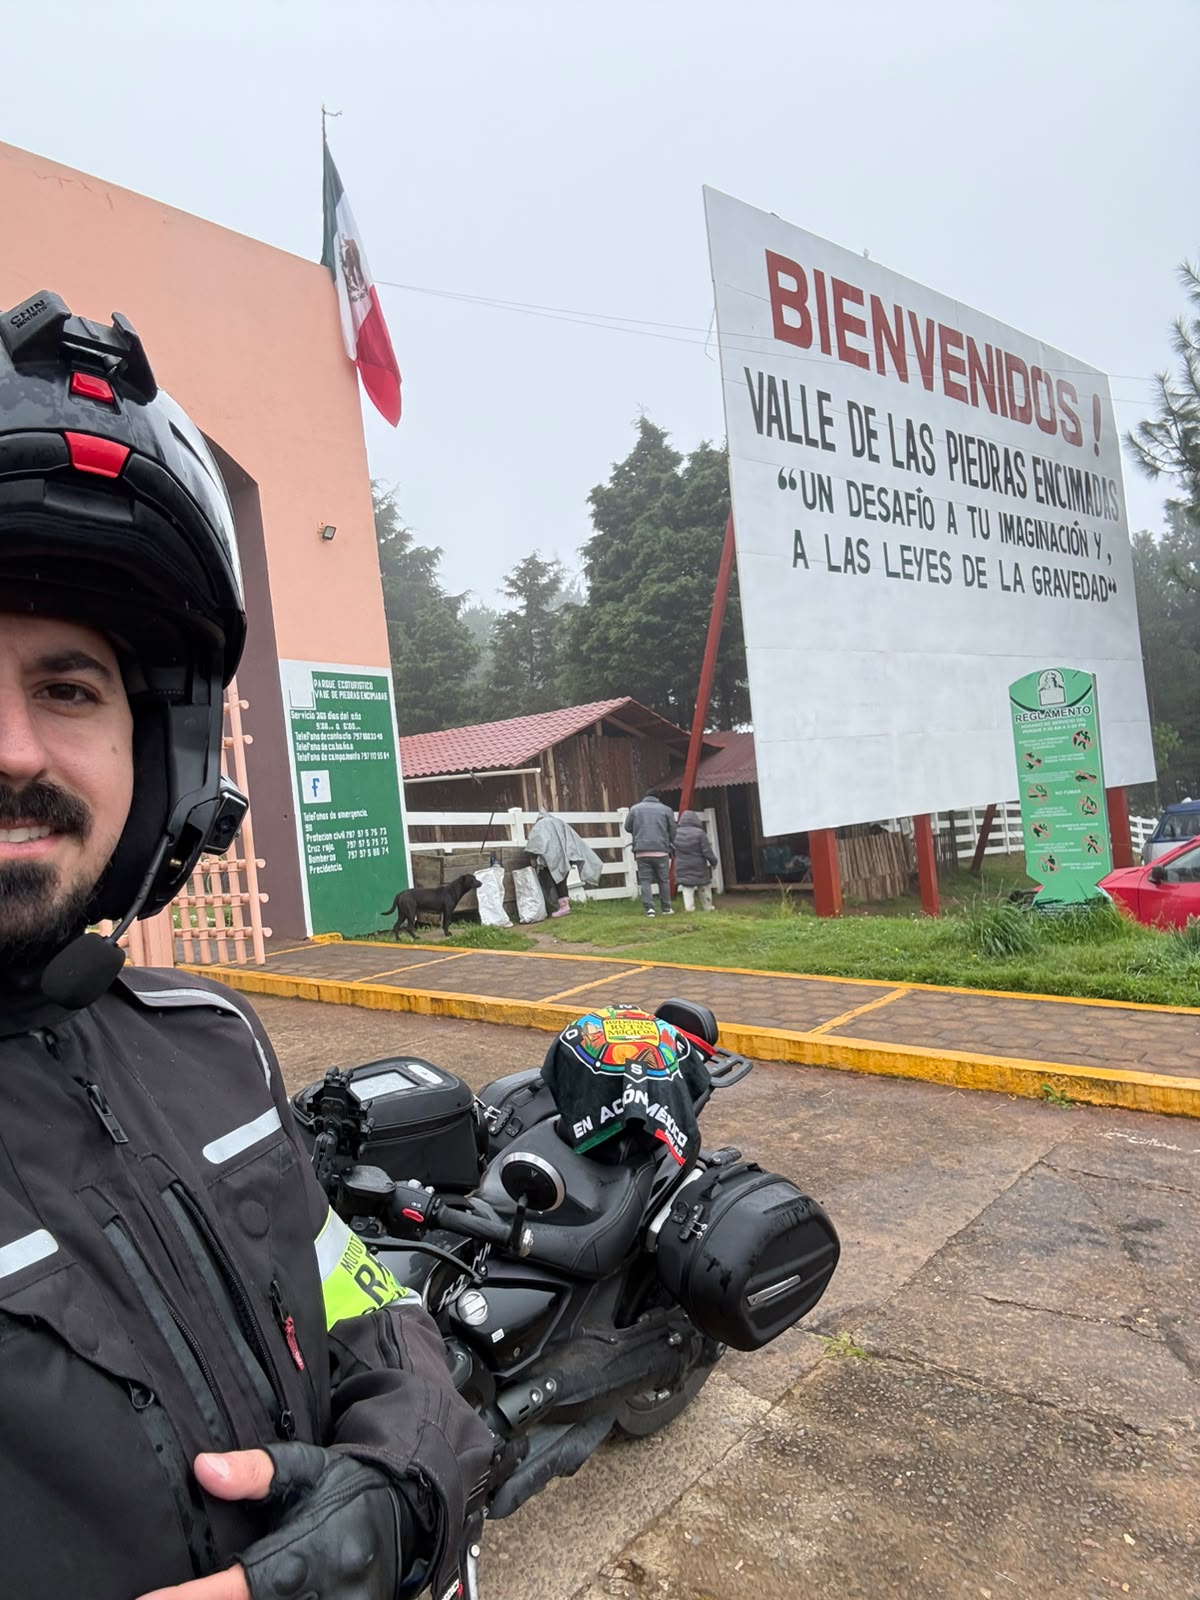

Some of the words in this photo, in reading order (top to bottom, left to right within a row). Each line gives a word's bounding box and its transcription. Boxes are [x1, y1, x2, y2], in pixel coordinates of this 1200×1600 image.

[765, 248, 1083, 447] BIENVENIDOS
[744, 366, 837, 452] VALLE
[847, 400, 881, 464] DE
[887, 412, 936, 477] LAS
[946, 429, 1028, 499] PIEDRAS
[1032, 455, 1120, 522] ENCIMADAS
[846, 480, 935, 531] DESAFÍO
[947, 501, 958, 535] A
[967, 505, 991, 540] TU
[998, 511, 1089, 558] IMAGINACIÓN
[792, 529, 810, 570] A
[824, 533, 871, 575] LAS
[883, 541, 952, 585] LEYES
[962, 553, 988, 589] DE
[998, 559, 1026, 593] LA
[313, 679, 336, 689] PARQUE
[331, 690, 339, 699] DE
[339, 691, 360, 700] PIEDRAS
[1015, 705, 1091, 722] REGLAMENTO
[307, 844, 321, 853] Cruz
[630, 1063, 643, 1075] S
[572, 1115, 594, 1139] EN
